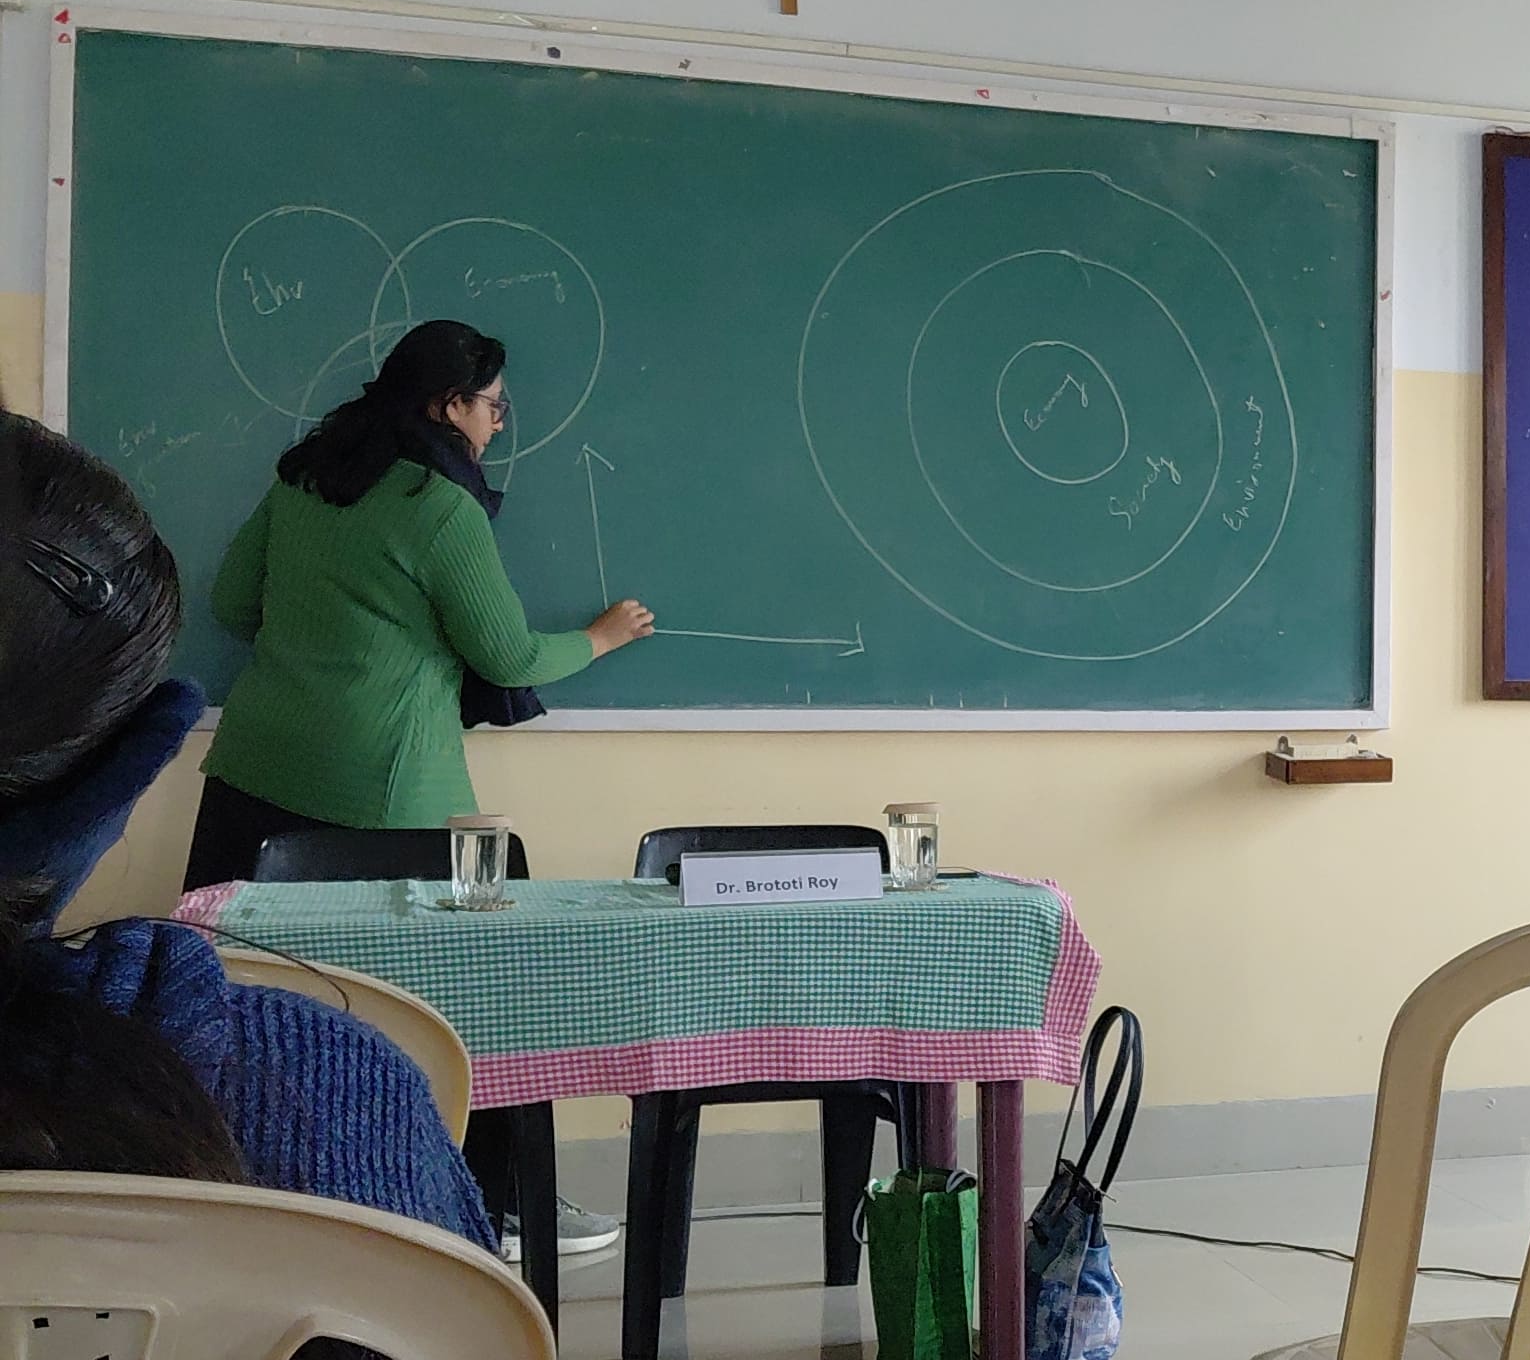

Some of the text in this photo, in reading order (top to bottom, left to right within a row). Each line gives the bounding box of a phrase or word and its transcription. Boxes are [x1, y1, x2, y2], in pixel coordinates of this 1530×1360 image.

[715, 875, 839, 895] Dr. Brototi Roy
